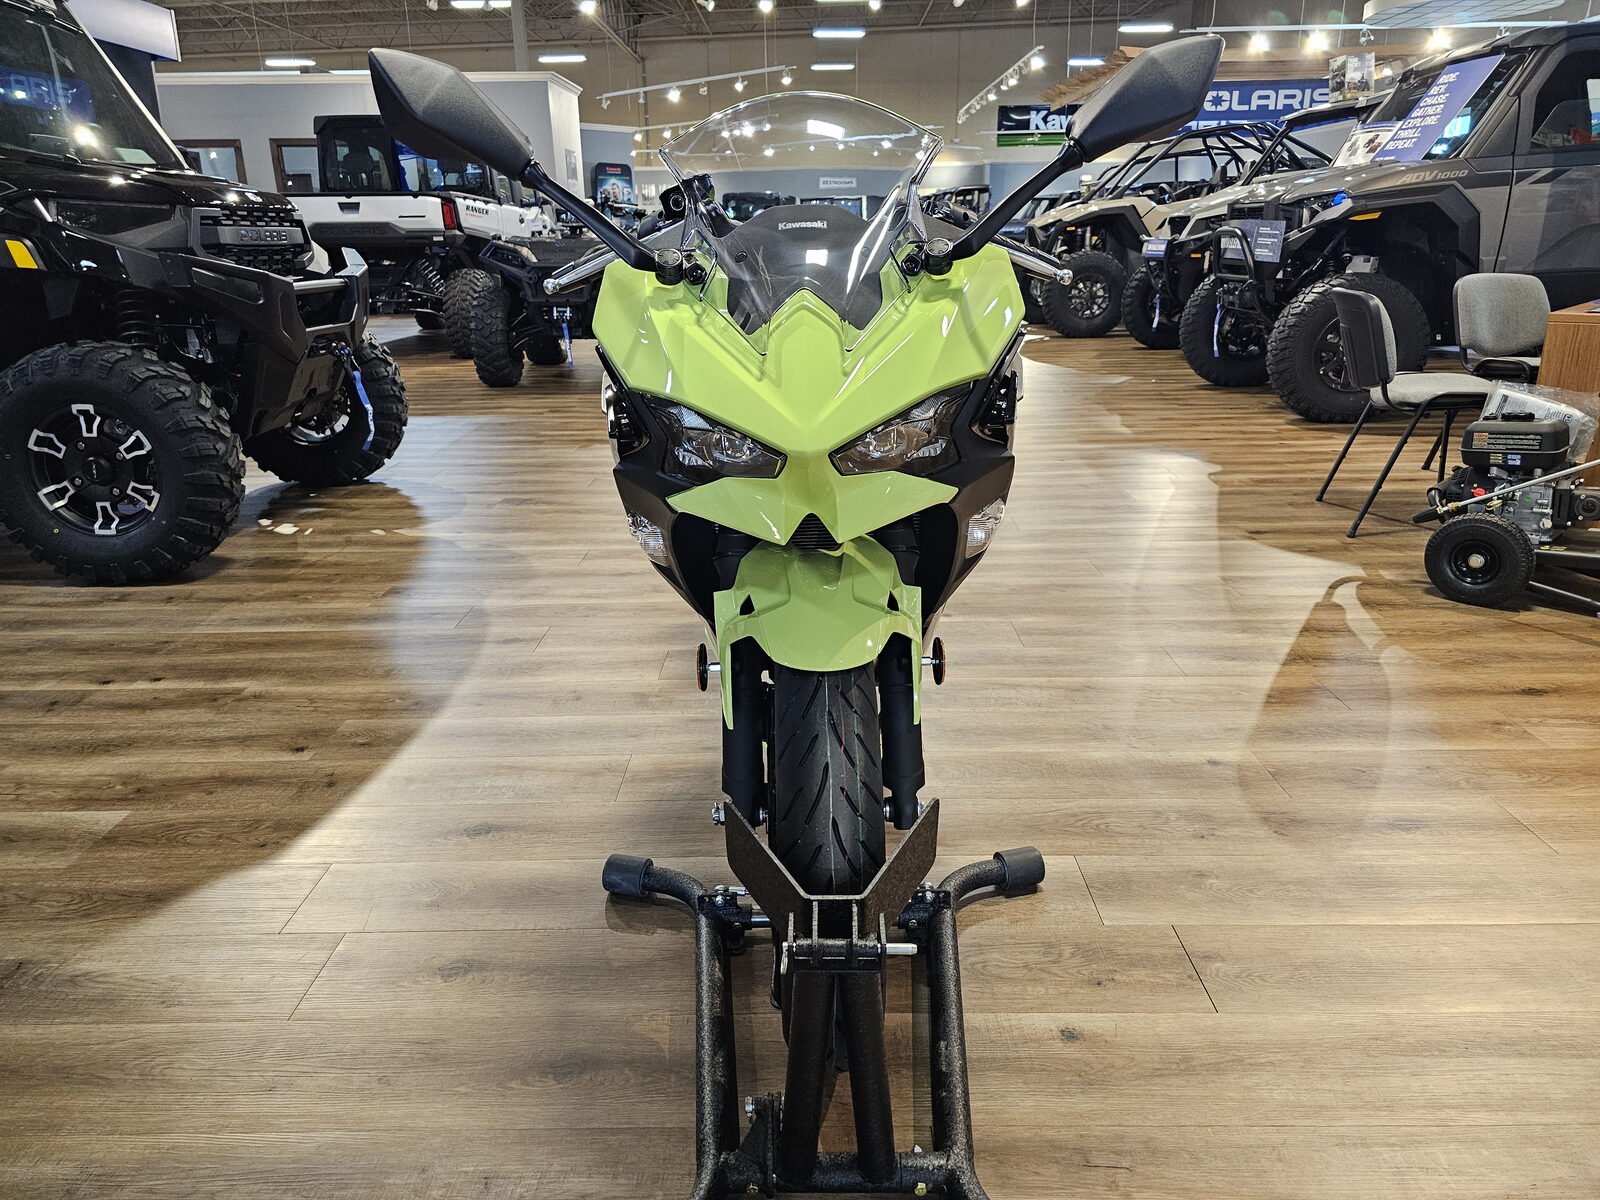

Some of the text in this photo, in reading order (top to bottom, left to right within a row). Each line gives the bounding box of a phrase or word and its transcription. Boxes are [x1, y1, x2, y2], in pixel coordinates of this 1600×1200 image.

[1203, 88, 1329, 111] OLARIS
[1384, 138, 1417, 150] REPEAT.
[1397, 169, 1468, 184] ADV 1000
[465, 205, 489, 216] RANGER
[778, 221, 828, 231] Kawasaki
[240, 229, 288, 242] POLARIS
